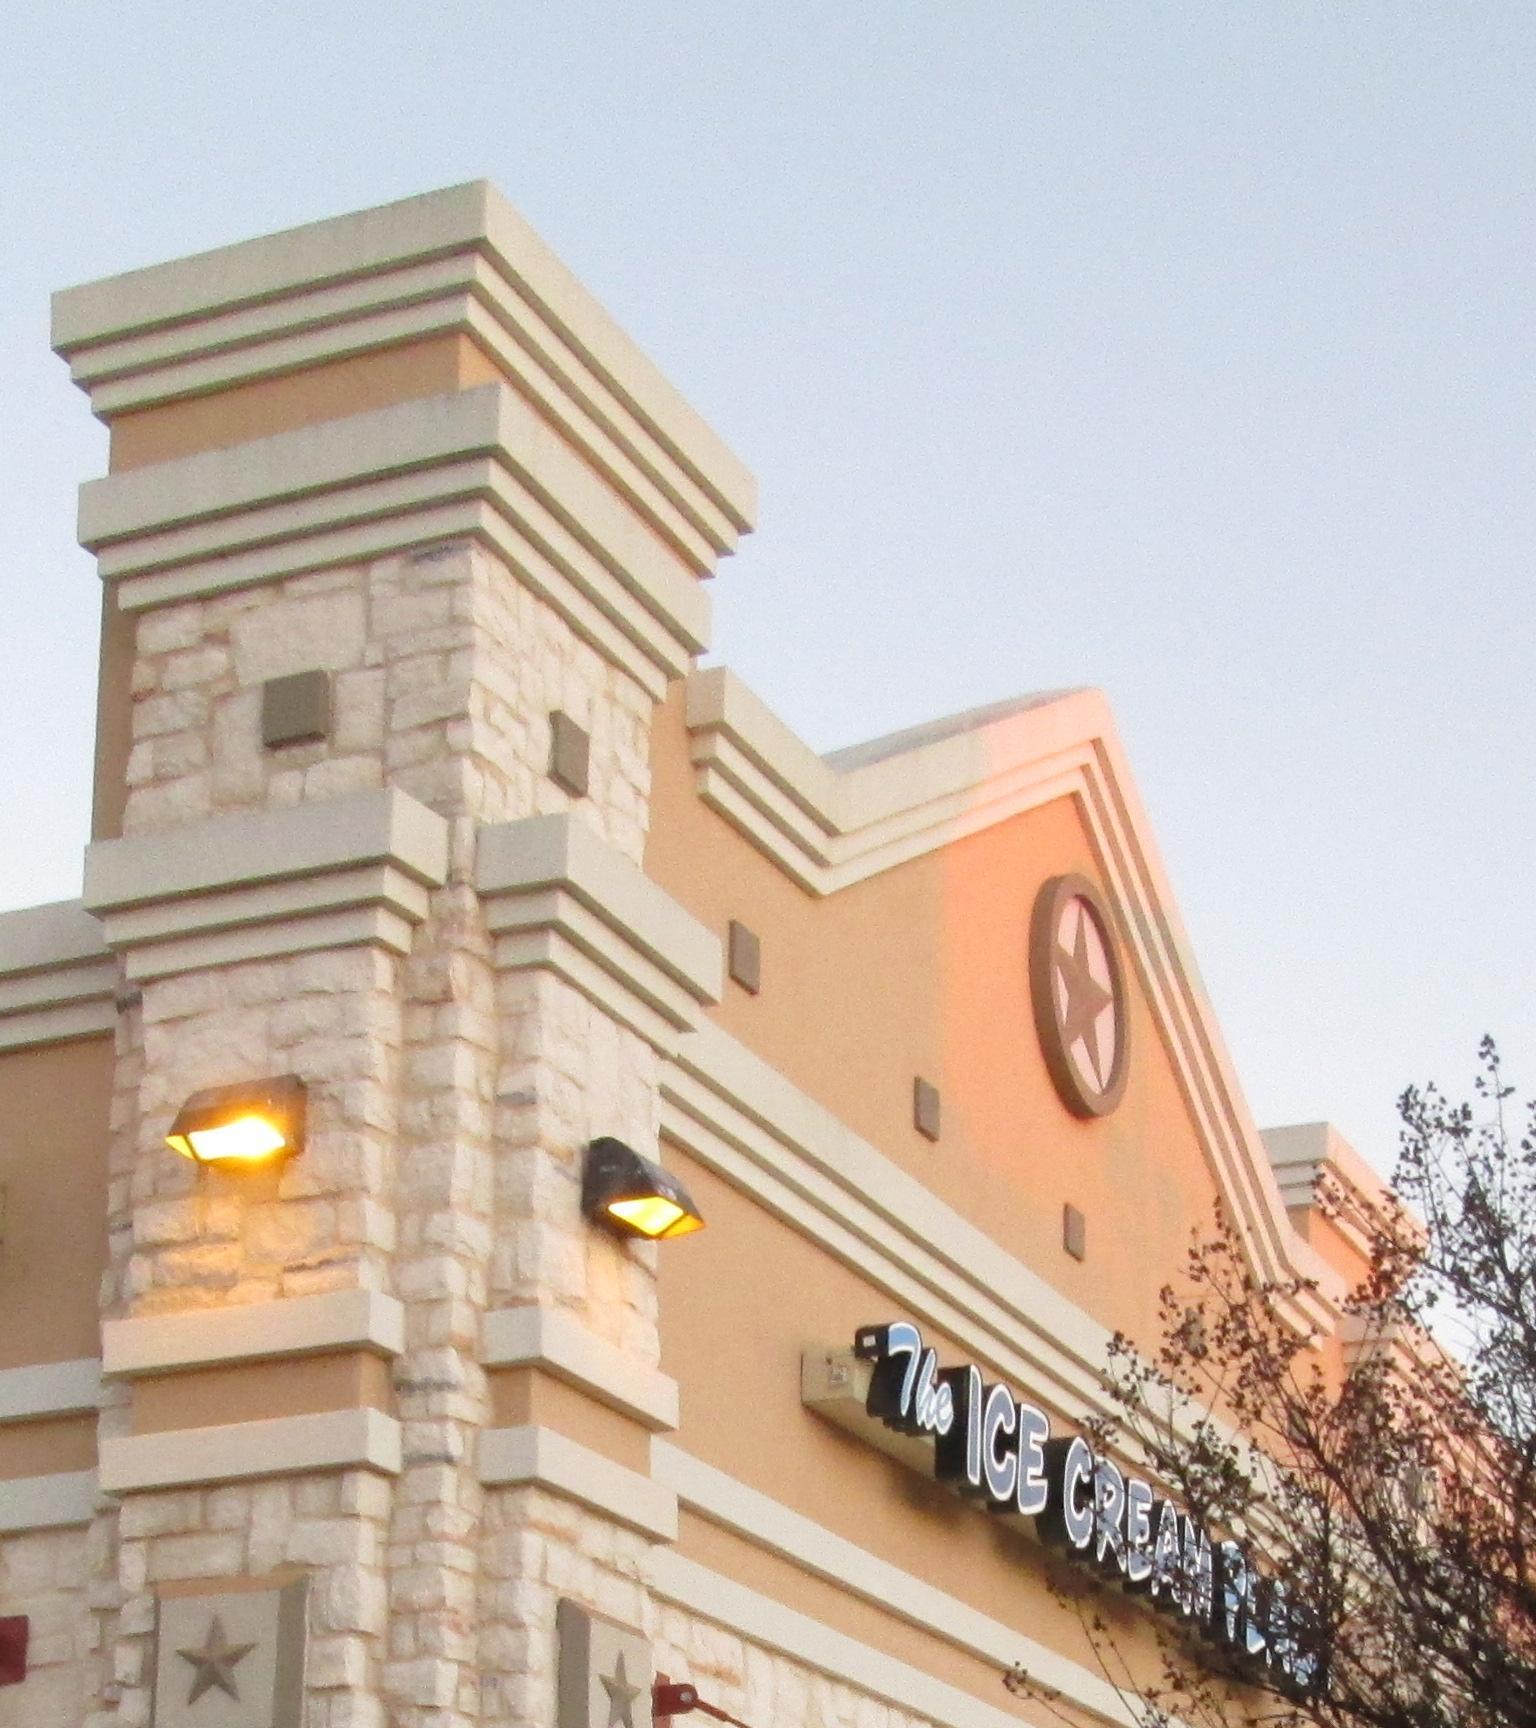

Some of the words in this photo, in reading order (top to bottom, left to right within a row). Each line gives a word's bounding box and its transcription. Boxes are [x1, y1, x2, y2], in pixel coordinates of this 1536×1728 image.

[887, 1321, 954, 1435] The
[966, 1363, 1050, 1516] ICE
[1064, 1436, 1213, 1624] CREAM
